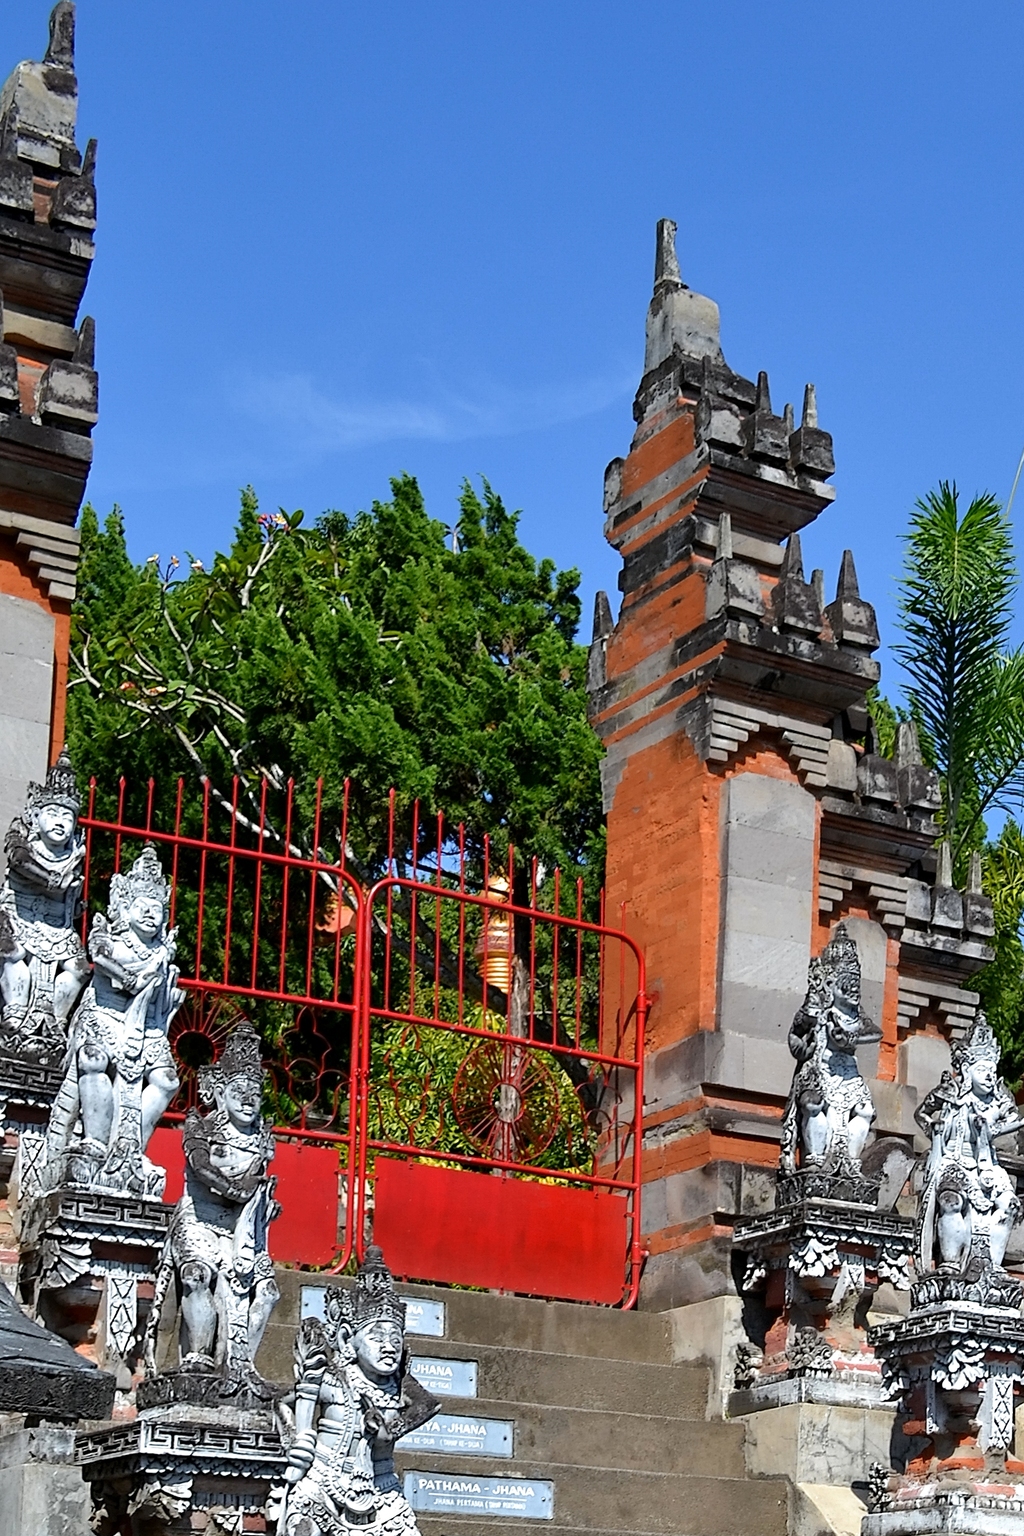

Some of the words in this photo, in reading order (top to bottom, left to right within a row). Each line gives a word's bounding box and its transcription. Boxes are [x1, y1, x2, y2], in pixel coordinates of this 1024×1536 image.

[412, 1364, 453, 1377] JHANA
[418, 1479, 481, 1493] PATHAMA
[492, 1485, 535, 1497] JHANA
